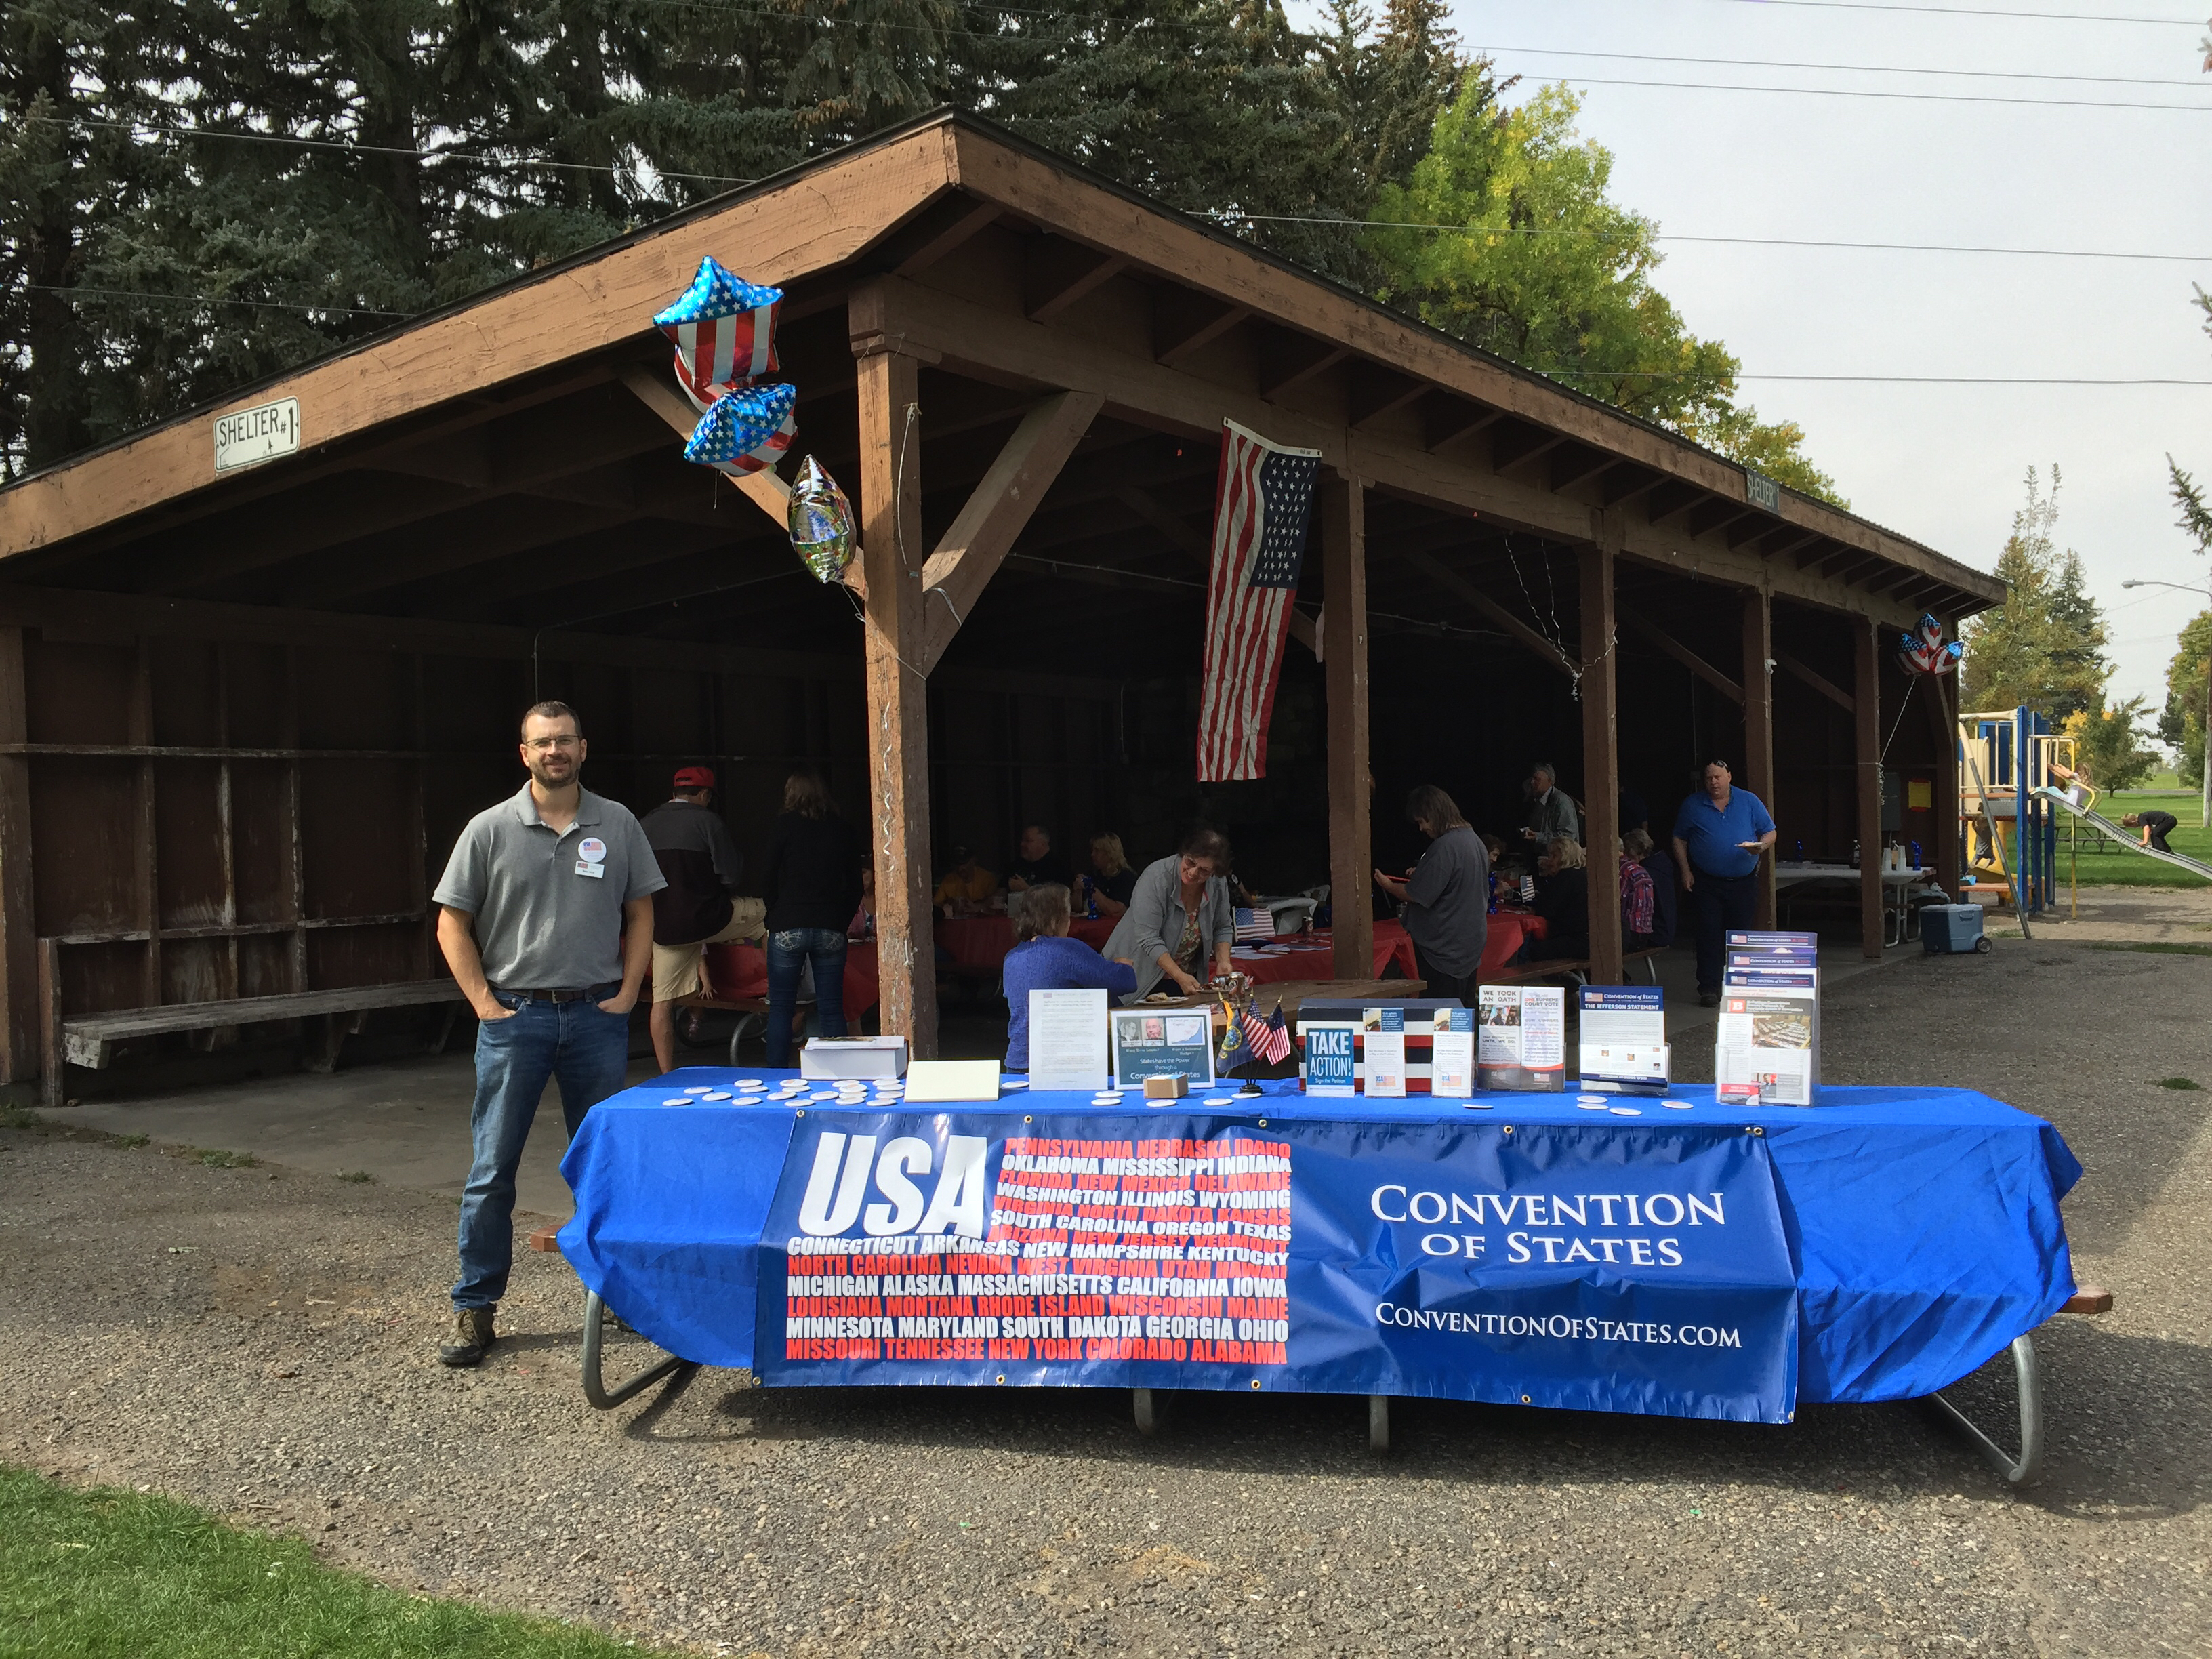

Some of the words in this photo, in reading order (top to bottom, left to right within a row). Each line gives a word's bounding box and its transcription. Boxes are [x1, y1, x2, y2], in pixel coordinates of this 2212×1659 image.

[219, 407, 279, 447] SHELTER
[1748, 474, 1774, 508] SHELTER
[1732, 1002, 1743, 1010] B
[1309, 1031, 1350, 1054] TAKE
[1310, 1057, 1351, 1076] ACTION!
[1005, 1137, 1133, 1158] PENNSYLVANIA
[1136, 1139, 1231, 1158] NEBRASKA
[1235, 1139, 1291, 1158] IDAHO
[1002, 1154, 1099, 1174] OKLAHOMA
[1103, 1158, 1214, 1176] MISSISSIPPI
[1218, 1155, 1292, 1175] INDIANA
[798, 1132, 987, 1239] USA
[999, 1170, 1072, 1189] FLORIDA
[1076, 1174, 1118, 1190] NEW
[1121, 1176, 1190, 1191] MEXICO
[1195, 1172, 1291, 1191] DELAWARE
[996, 1182, 1118, 1205] WASHINGTON
[1121, 1190, 1195, 1206] ILLINOIS
[1199, 1189, 1290, 1209] WYOMING
[1370, 1184, 1725, 1226] CONVENTION
[994, 1195, 1073, 1216] VIRGINIA
[1078, 1204, 1139, 1220] NORTH
[1142, 1206, 1213, 1222] DAKOTA
[1217, 1208, 1290, 1225] KANSAS
[991, 1209, 1052, 1229] SOUTH
[1056, 1215, 1148, 1234] CAROLINA
[1152, 1221, 1228, 1235] OREGON
[1233, 1221, 1292, 1241] TEXAS
[787, 1235, 919, 1256] CONNECTICUT
[920, 1235, 1020, 1256] ARKANSAS
[1023, 1242, 1068, 1258] NEW
[1070, 1244, 1183, 1260] HAMPSHIRE
[1187, 1246, 1290, 1266] KENTUCKY
[987, 1225, 1068, 1244] ARIZONA
[1073, 1230, 1118, 1246] NEW
[1121, 1234, 1190, 1247] JERSEY
[1194, 1234, 1289, 1253] VERMONT
[1420, 1233, 1486, 1259] OF
[1507, 1232, 1683, 1267] STATES
[787, 1256, 846, 1275] NORTH
[852, 1254, 942, 1275] CAROLINA
[946, 1254, 1012, 1275] NEVADA
[1017, 1256, 1069, 1276] WEST
[1072, 1258, 1158, 1277] VIRGINIA
[1162, 1261, 1211, 1279] UTAH
[1216, 1261, 1287, 1279] HAWAII
[787, 1275, 879, 1296] MICHIGAN
[882, 1275, 954, 1296] ALASKA
[958, 1273, 1113, 1296] MASSACHUSETTS
[1117, 1276, 1229, 1297] CALIFORNIA
[1233, 1277, 1288, 1298] IOWA
[787, 1296, 882, 1317] LOUISIANA
[886, 1296, 974, 1317] MONTANA
[977, 1296, 1036, 1317] RHODE
[1039, 1295, 1105, 1316] ISLAND
[1109, 1295, 1222, 1318] WISCONSIN
[1227, 1297, 1289, 1319] MAINE
[786, 1317, 895, 1338] MINNESOTA
[899, 1316, 998, 1338] MARYLAND
[1002, 1316, 1064, 1338] SOUTH
[1069, 1315, 1142, 1338] DAKOTA
[1146, 1315, 1234, 1340] GEORGIA
[1238, 1319, 1288, 1343] OHIO
[1375, 1302, 1743, 1348] CONVENTIONOFSTATES.COM
[786, 1338, 880, 1360] MISSOURI
[884, 1338, 984, 1360] TENNESSEE
[988, 1338, 1029, 1360] NEW
[1033, 1338, 1083, 1360] YORK
[1086, 1337, 1187, 1361] COLORADO
[1191, 1340, 1288, 1364] ALABAMA
